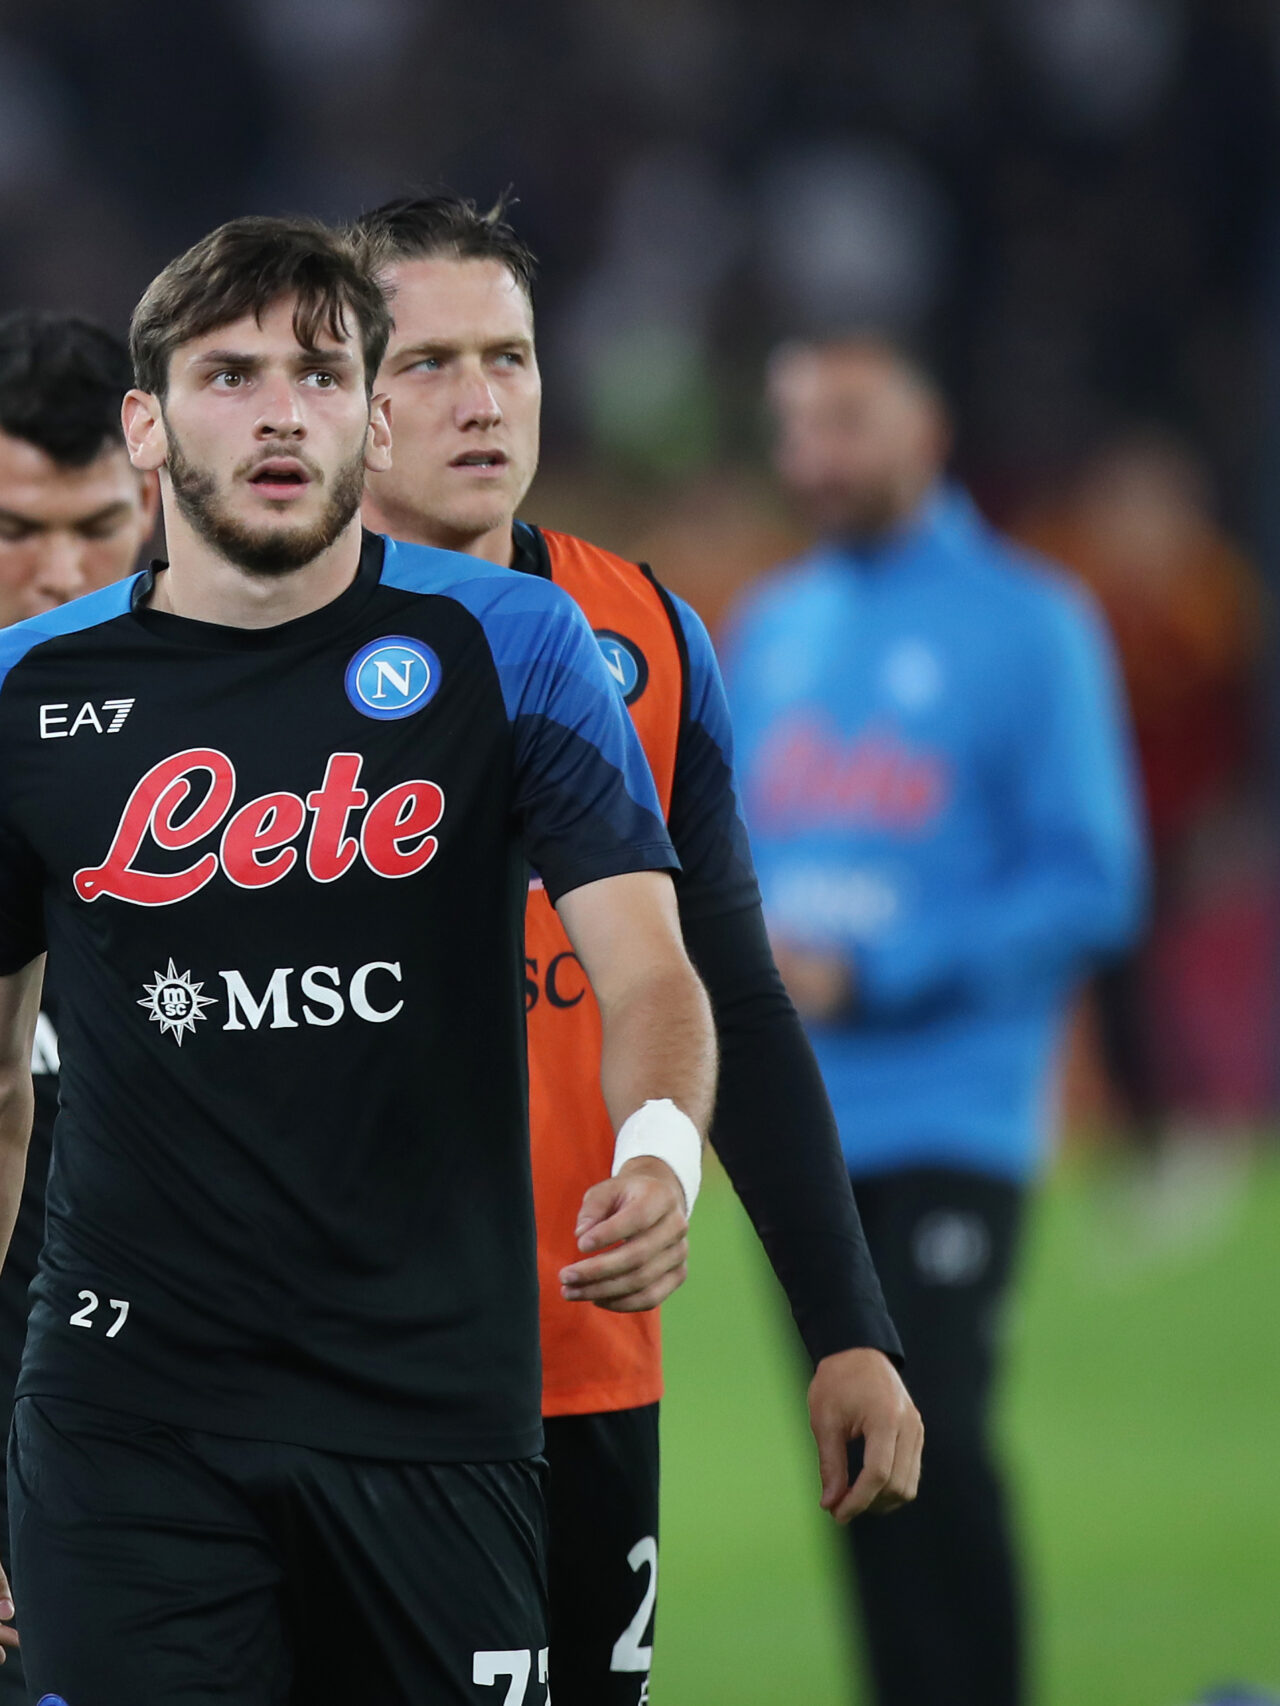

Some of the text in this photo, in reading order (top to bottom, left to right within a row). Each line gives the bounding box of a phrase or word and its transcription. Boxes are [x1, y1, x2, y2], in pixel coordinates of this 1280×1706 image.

[372, 660, 416, 699] N
[40, 698, 136, 739] EA7
[73, 747, 445, 906] Lete
[218, 961, 404, 1030] MSC
[69, 1289, 130, 1338] 27
